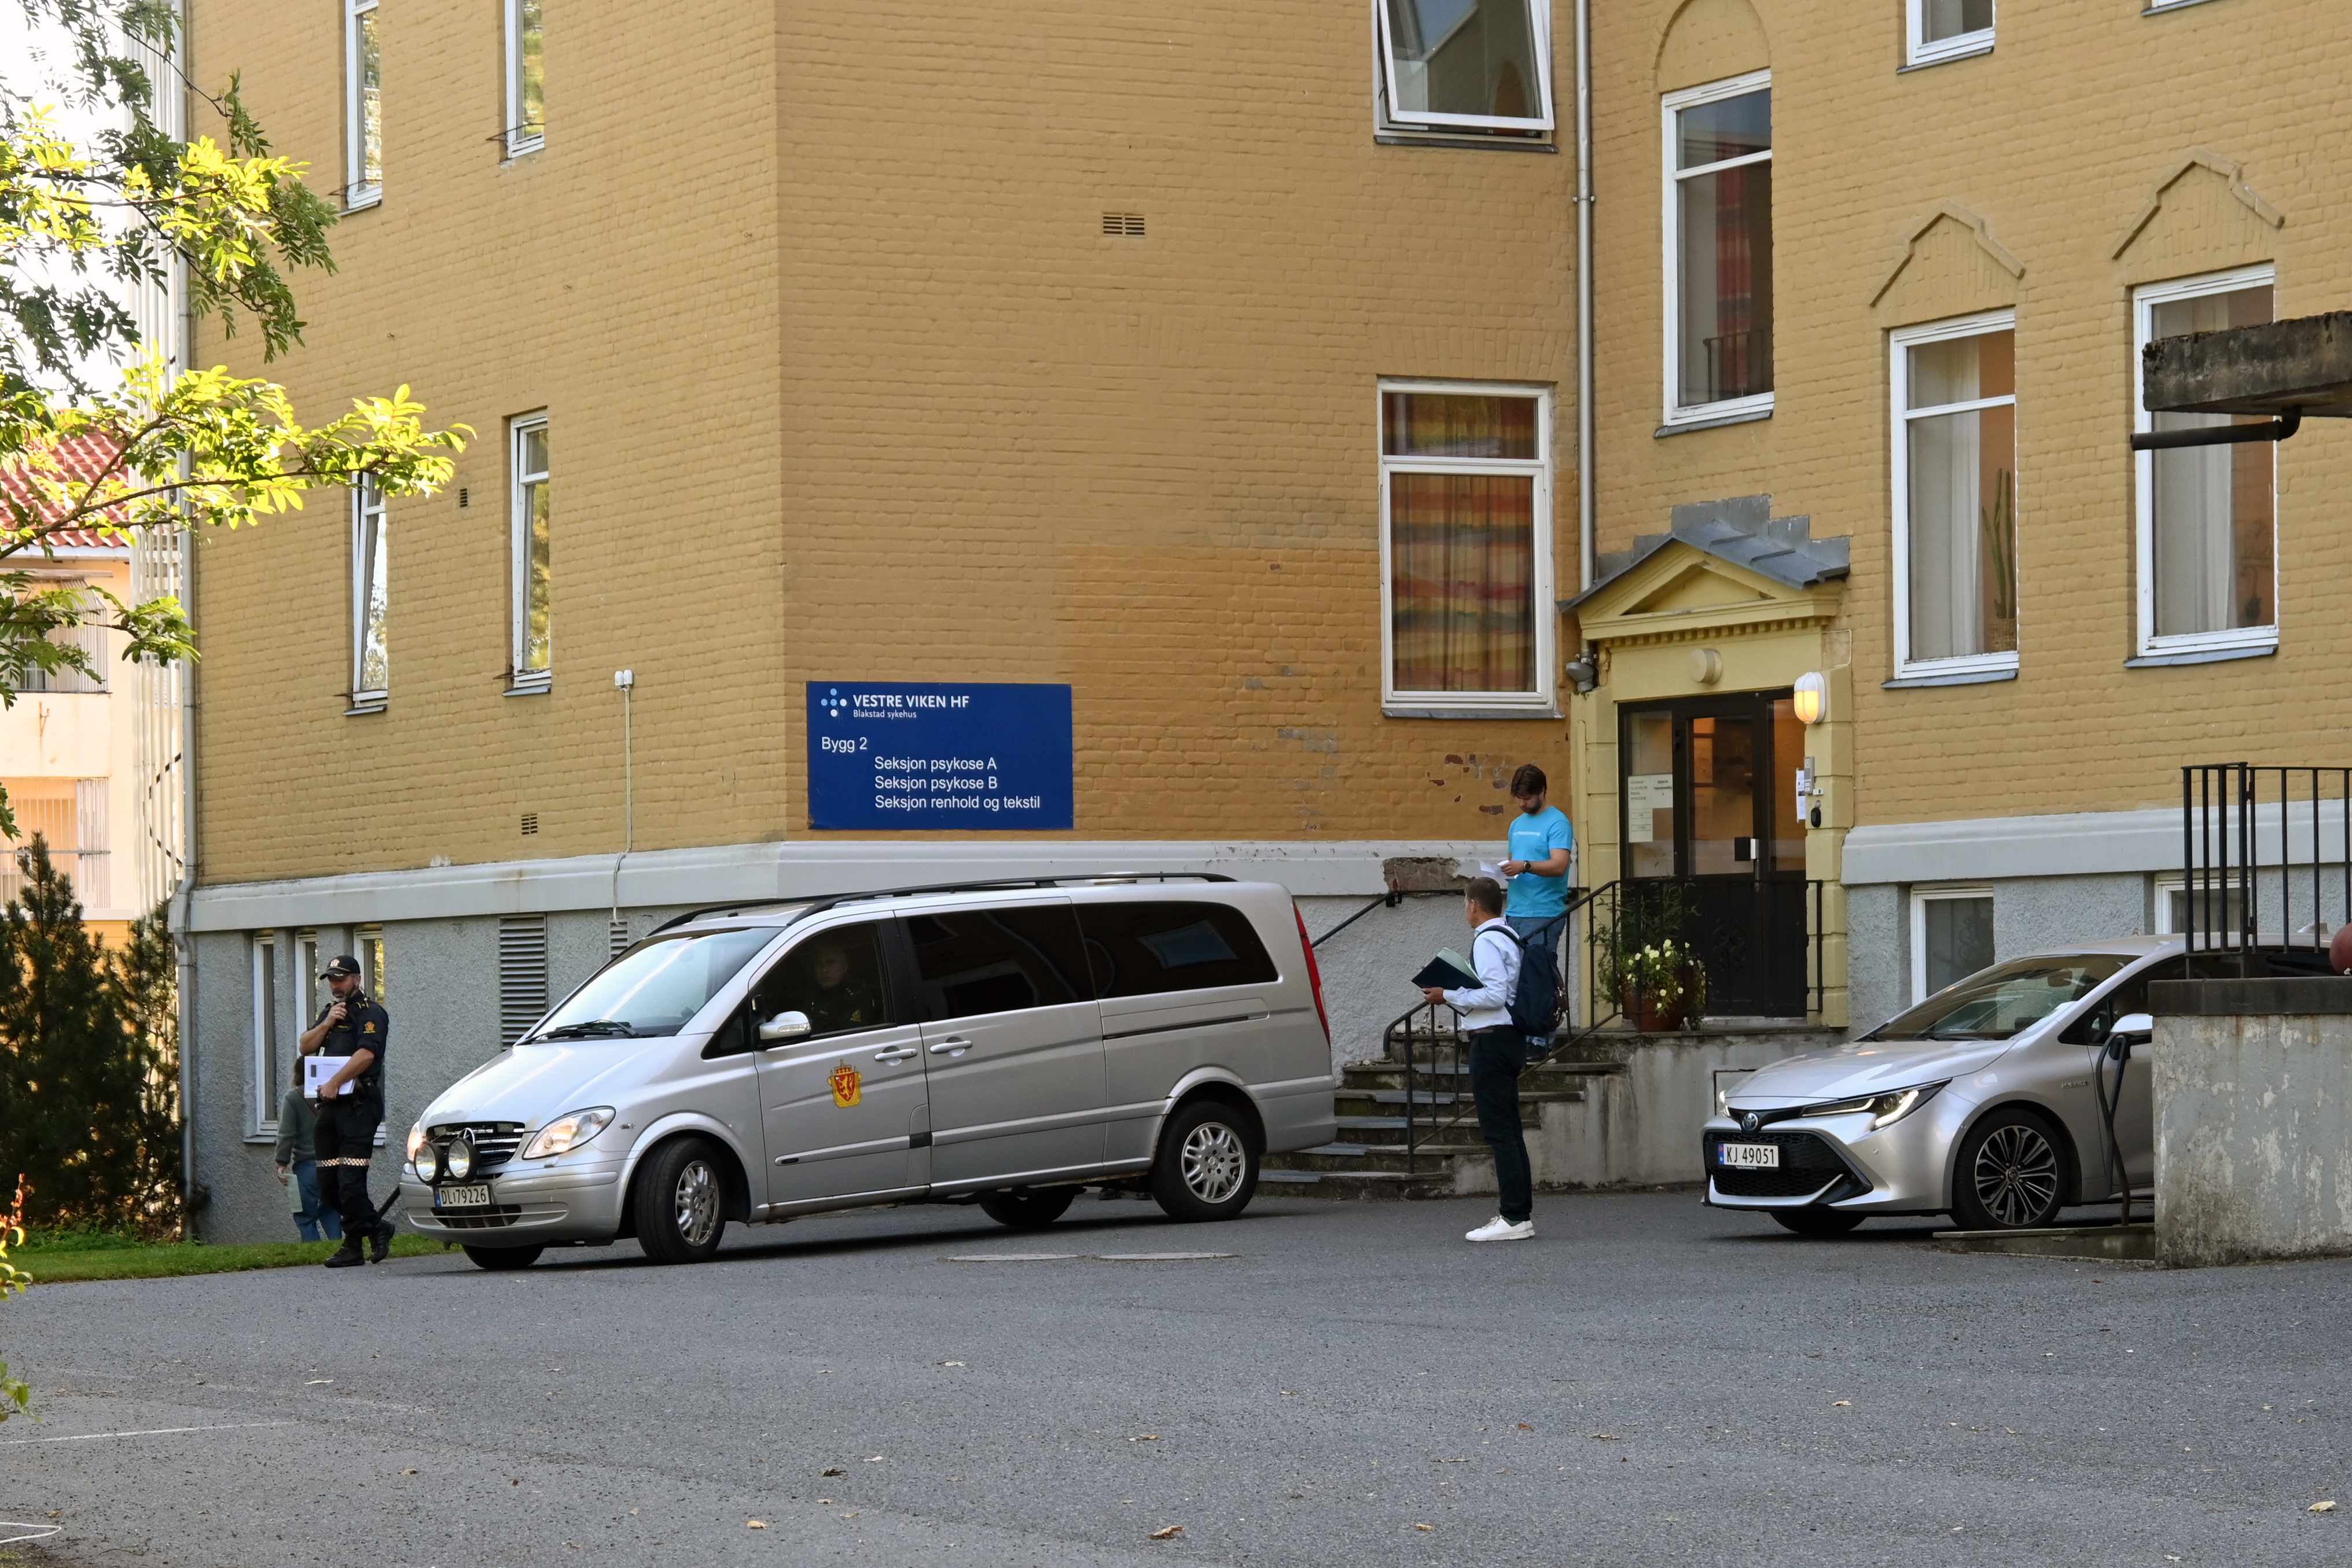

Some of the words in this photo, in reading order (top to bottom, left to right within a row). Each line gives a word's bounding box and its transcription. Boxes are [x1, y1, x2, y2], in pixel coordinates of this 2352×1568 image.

[852, 694, 903, 708] VESTRE
[906, 695, 946, 708] VIKEN
[950, 695, 969, 708] HF
[853, 709, 885, 718] Blakstad
[887, 709, 917, 720] sykehus
[821, 736, 855, 753] Bygg
[859, 737, 868, 750] 2
[874, 756, 927, 772] Seksjon
[931, 756, 984, 773] psykose
[987, 757, 997, 770] A
[874, 775, 927, 792] Seksjon
[931, 776, 984, 792] psykose
[988, 776, 998, 789] B
[874, 794, 927, 812] Seksjon
[931, 795, 979, 808] renhold
[983, 798, 999, 812] og
[1003, 795, 1040, 808] tekstil
[1726, 1146, 1737, 1163] KJ
[1742, 1147, 1774, 1165] 49051
[441, 1190, 453, 1205] DL
[455, 1188, 486, 1204] 79226
